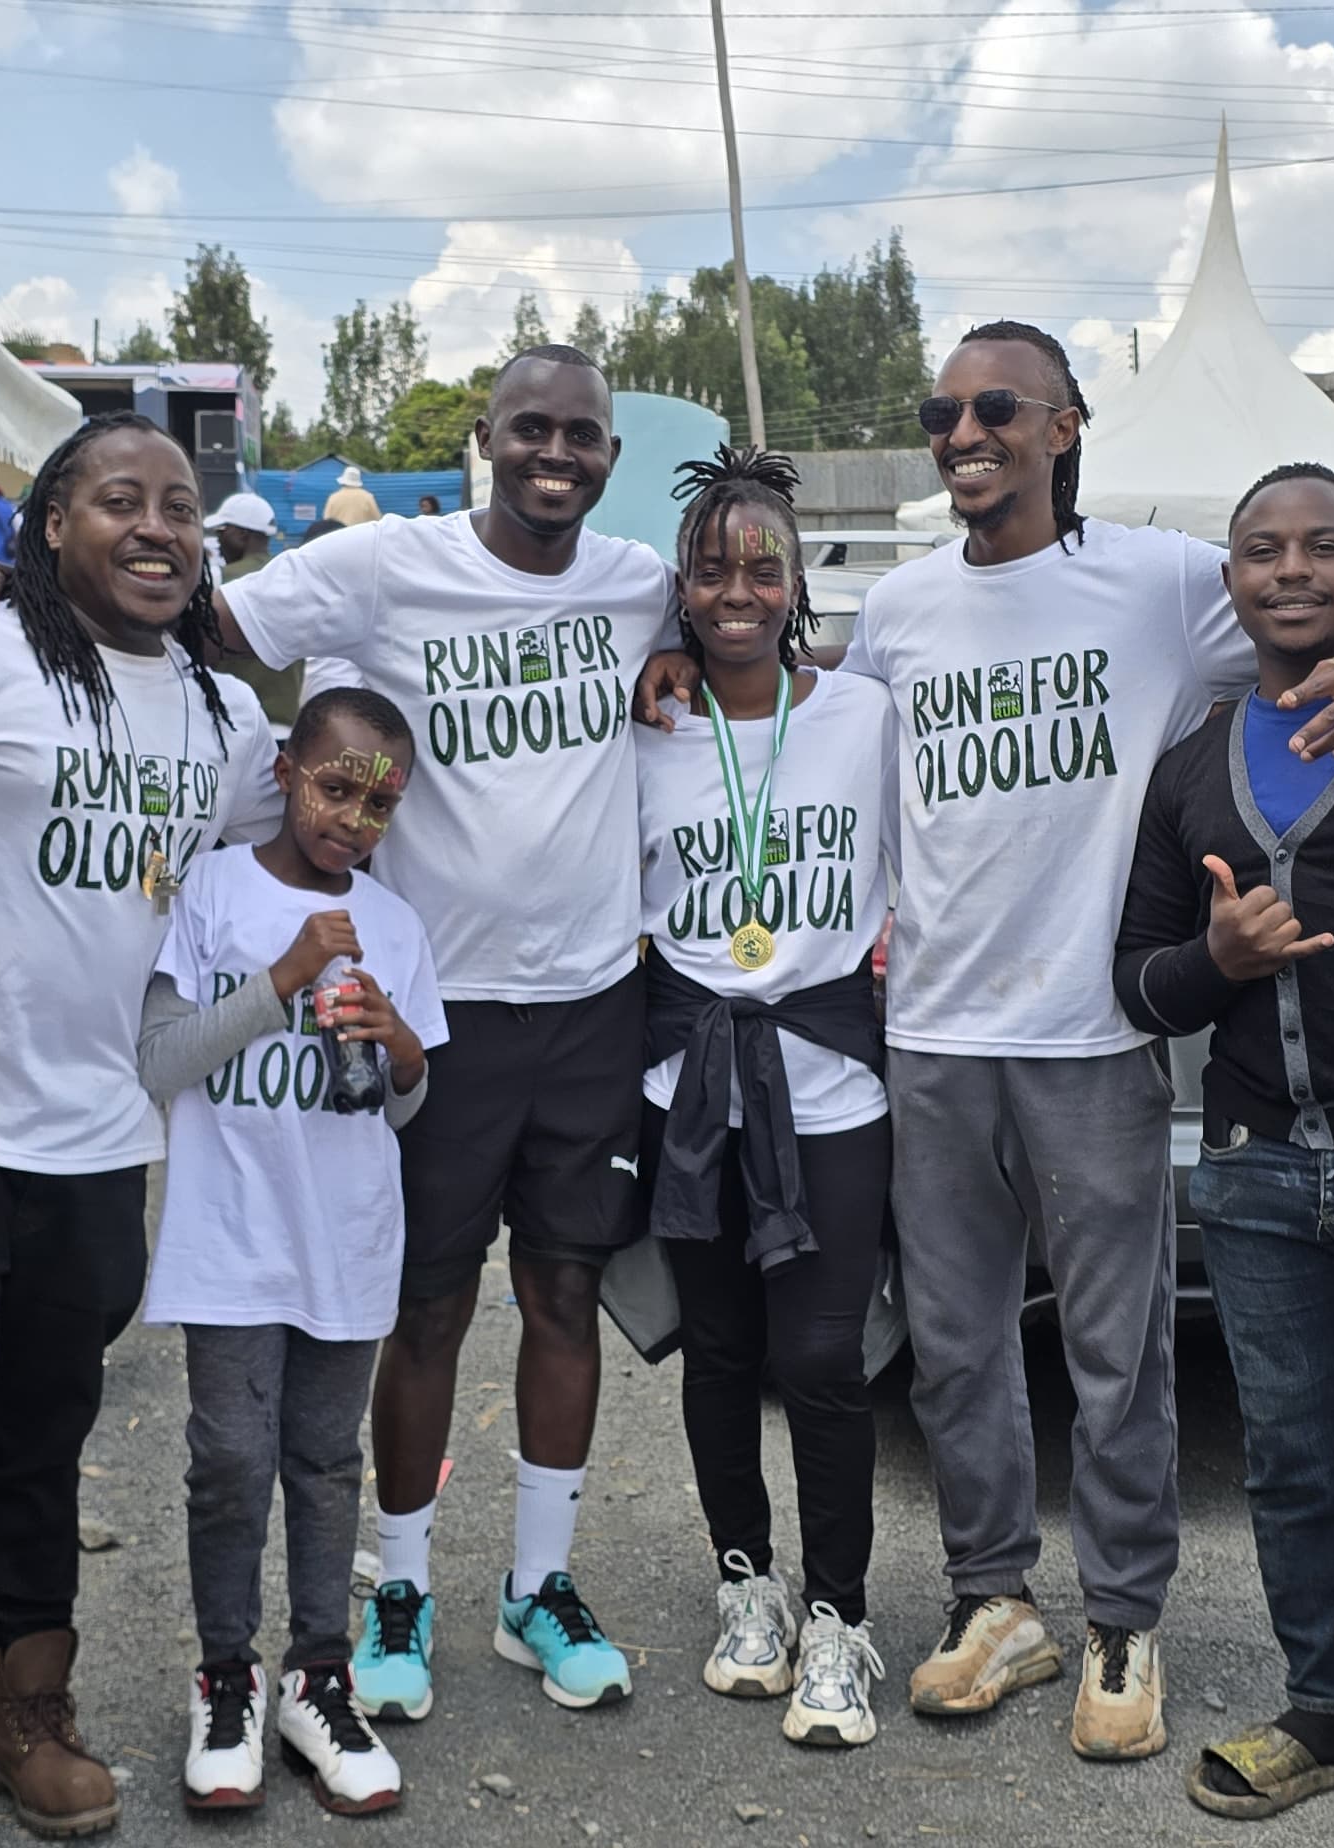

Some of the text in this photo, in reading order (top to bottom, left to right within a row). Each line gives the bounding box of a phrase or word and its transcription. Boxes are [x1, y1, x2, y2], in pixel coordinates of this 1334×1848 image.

[423, 615, 620, 696] RUN FOR
[523, 668, 550, 682] RUN
[913, 649, 1110, 738] RUN FOR
[429, 675, 626, 767] OLOOLUA
[993, 704, 1022, 719] RUN
[51, 746, 219, 822] RUN FOR
[915, 712, 1118, 807] OLOOLUA
[38, 816, 205, 893] OLOO
[796, 804, 857, 863] FOR
[667, 867, 854, 941] OLOOLUA
[205, 1041, 380, 1116] OLOO
